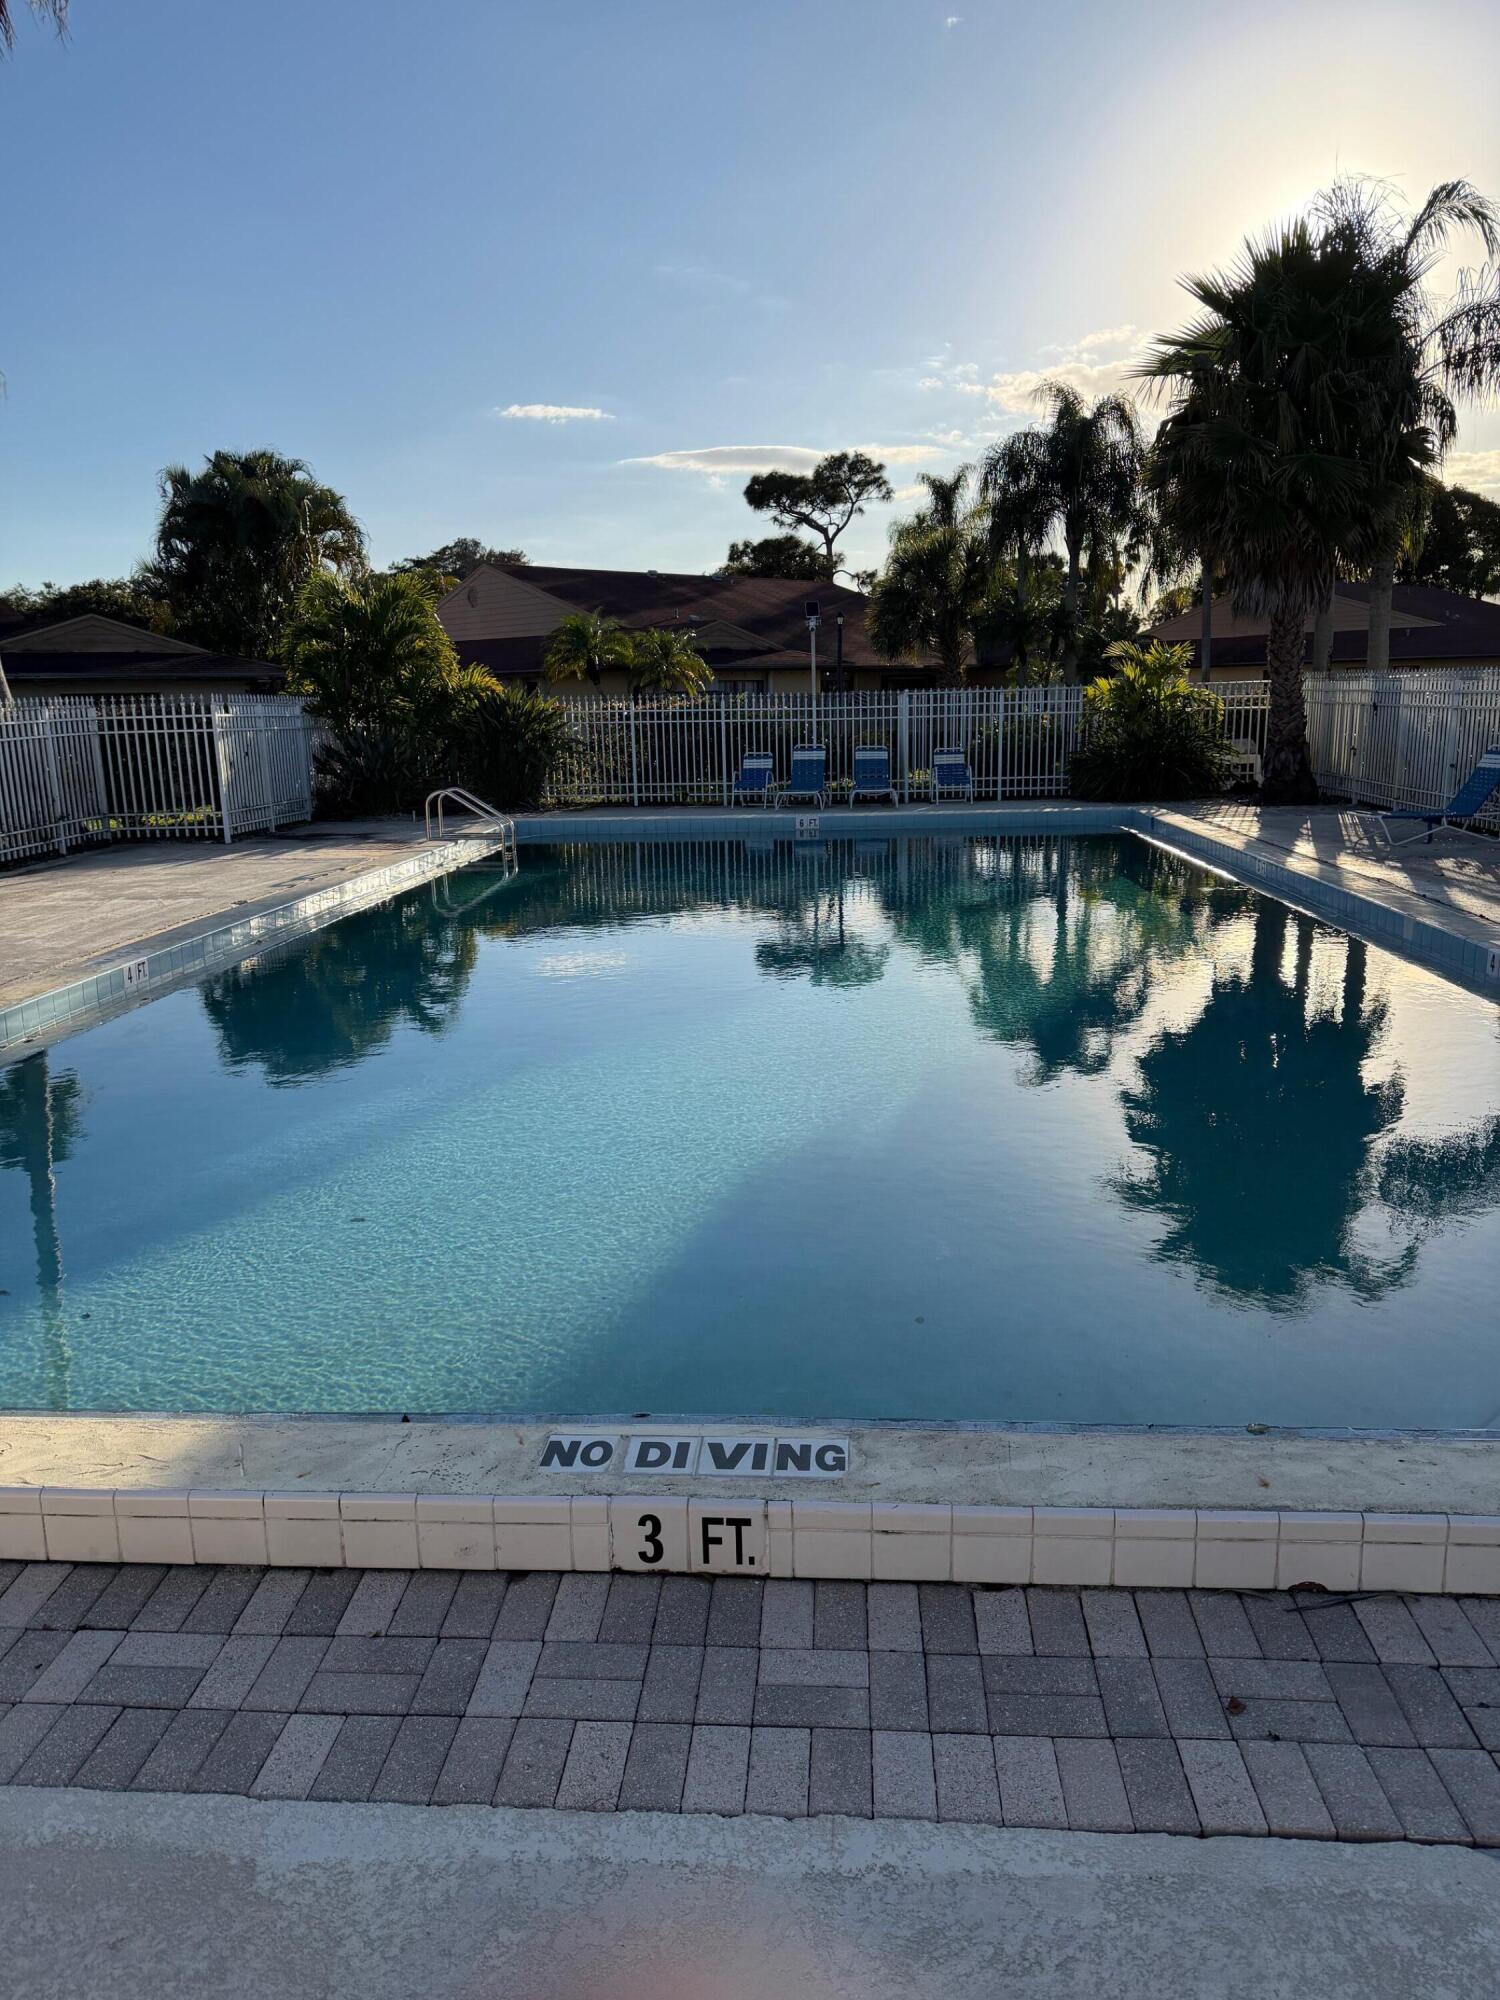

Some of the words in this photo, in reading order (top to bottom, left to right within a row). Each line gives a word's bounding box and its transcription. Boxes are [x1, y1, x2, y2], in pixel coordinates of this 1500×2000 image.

[799, 818, 805, 828] 6
[1490, 953, 1496, 973] 4
[127, 965, 133, 984] 4
[539, 1440, 614, 1467] NO
[637, 1513, 664, 1564] 3
[701, 1517, 756, 1566] FT.
